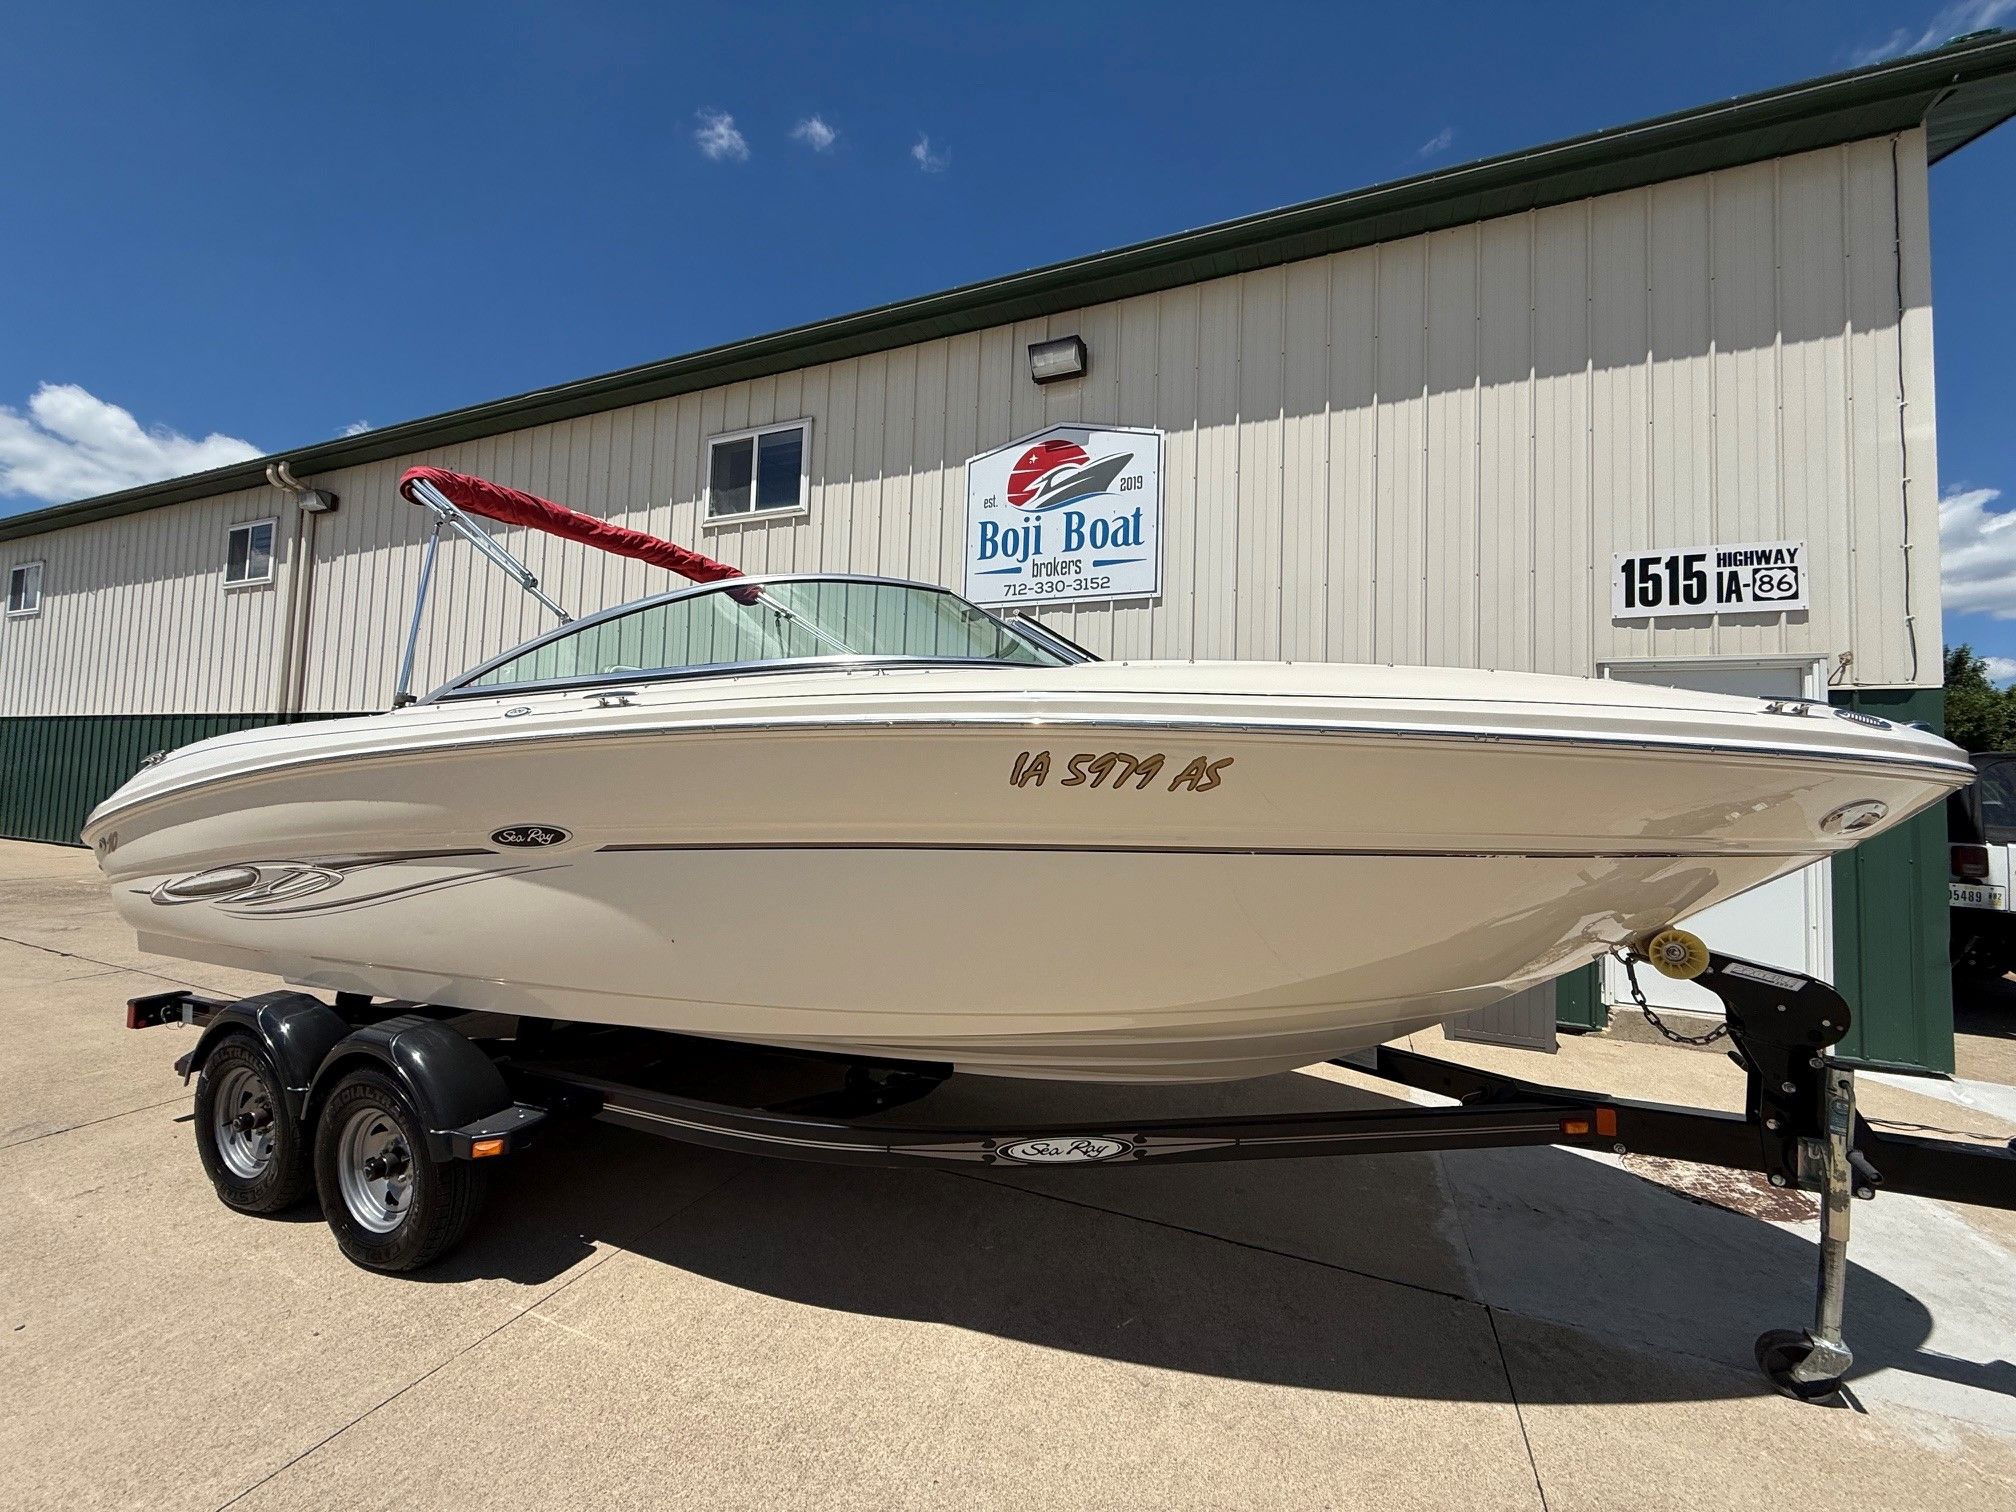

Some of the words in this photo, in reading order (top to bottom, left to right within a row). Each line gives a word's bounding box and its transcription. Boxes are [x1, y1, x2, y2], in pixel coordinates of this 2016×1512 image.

[1119, 475, 1143, 492] 2019
[983, 495, 999, 509] est.
[976, 515, 1043, 563] Boji
[1061, 507, 1145, 553] Boat
[1031, 557, 1082, 579] brokers
[1716, 548, 1799, 568] HIGHWAY
[1003, 576, 1111, 597] 712-330-3152
[1621, 553, 1707, 608] 1515
[1060, 751, 1166, 790] 5979
[1167, 755, 1235, 793] AS
[498, 830, 526, 843] Sea
[526, 828, 555, 845] Ray
[1021, 1142, 1064, 1156] Sea
[1066, 1140, 1110, 1158] Ray
